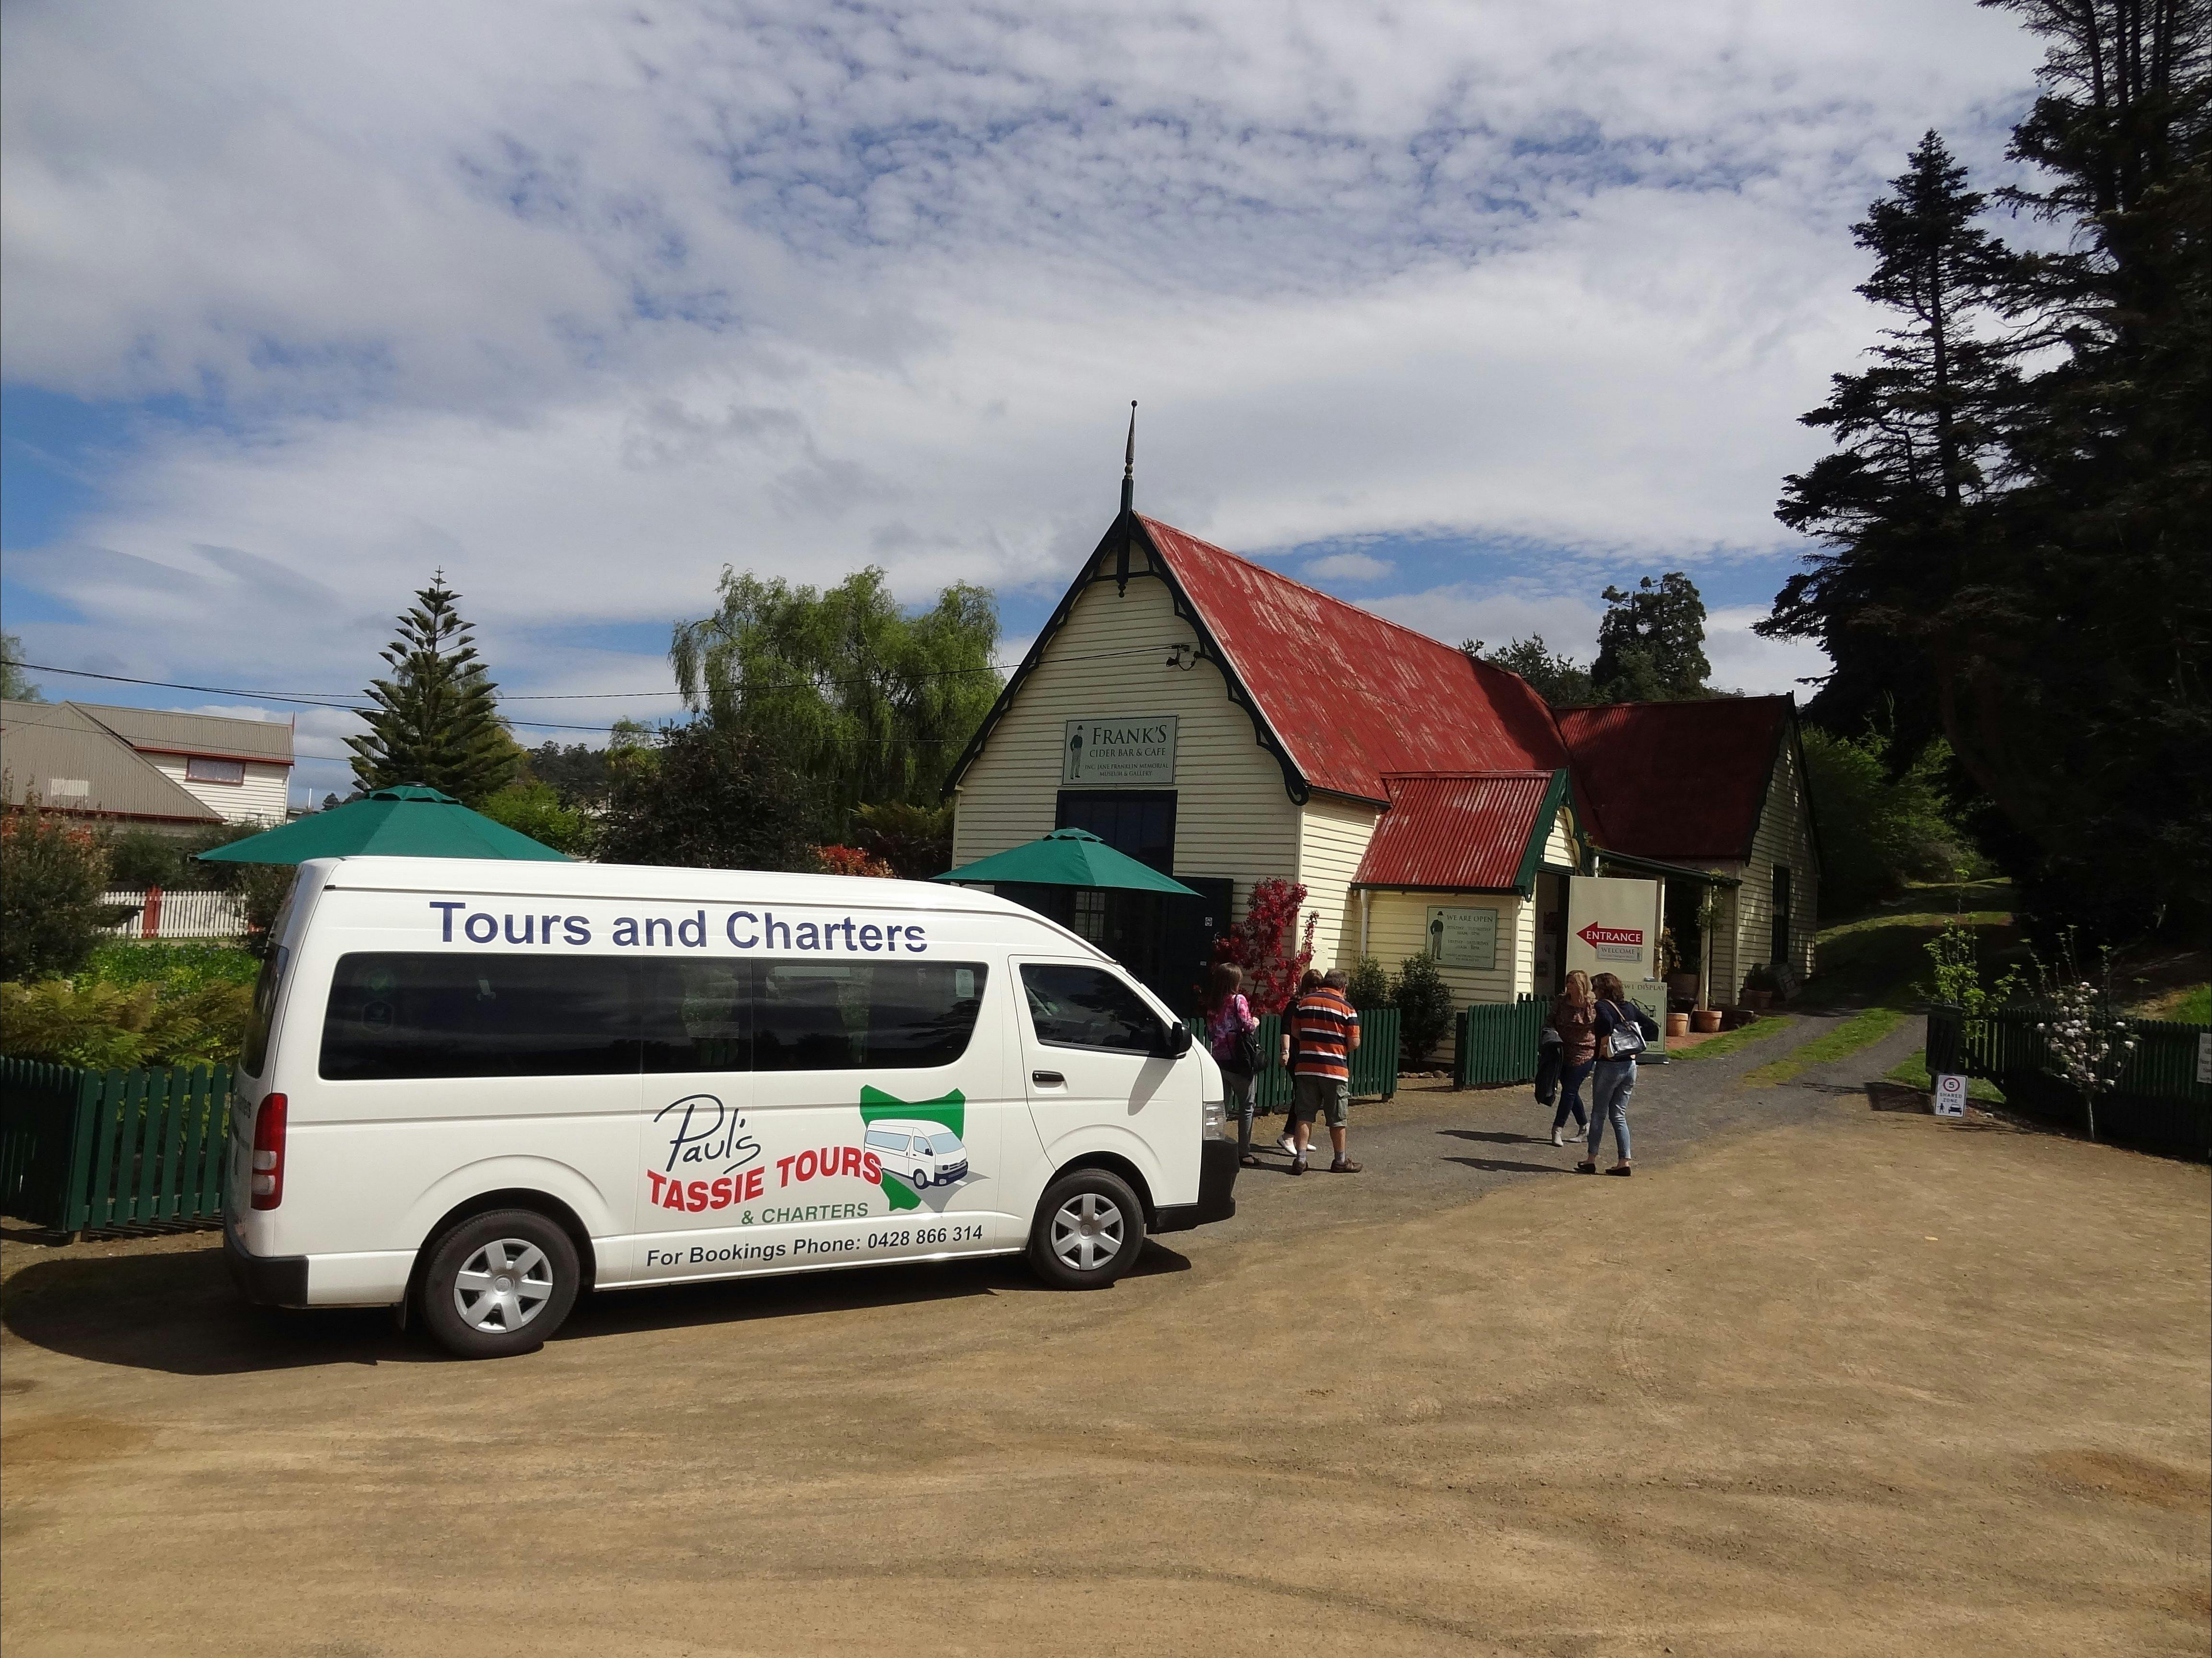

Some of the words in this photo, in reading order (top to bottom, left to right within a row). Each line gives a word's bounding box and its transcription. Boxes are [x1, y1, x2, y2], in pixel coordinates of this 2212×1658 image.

[1093, 724, 1166, 745] FRANK'S
[1090, 749, 1116, 758] CIDER
[1118, 748, 1134, 757] BAR
[1144, 747, 1166, 756] CAFE
[429, 901, 593, 947] Tours
[612, 911, 707, 948] and
[726, 911, 928, 952] Charters
[1586, 931, 1641, 942] ENTRANCE
[1601, 947, 1635, 955] WELCOME
[654, 1094, 761, 1174] Paul's
[646, 1165, 766, 1213] TASSIE
[775, 1146, 883, 1186] TOURS
[741, 1210, 753, 1225] &
[761, 1202, 868, 1224] CHARTERS
[647, 1249, 683, 1267] For
[689, 1240, 786, 1264] Bookings
[793, 1235, 861, 1255] Phone:
[868, 1230, 910, 1249] 0428
[916, 1226, 947, 1244] 866
[952, 1224, 983, 1242] 314
